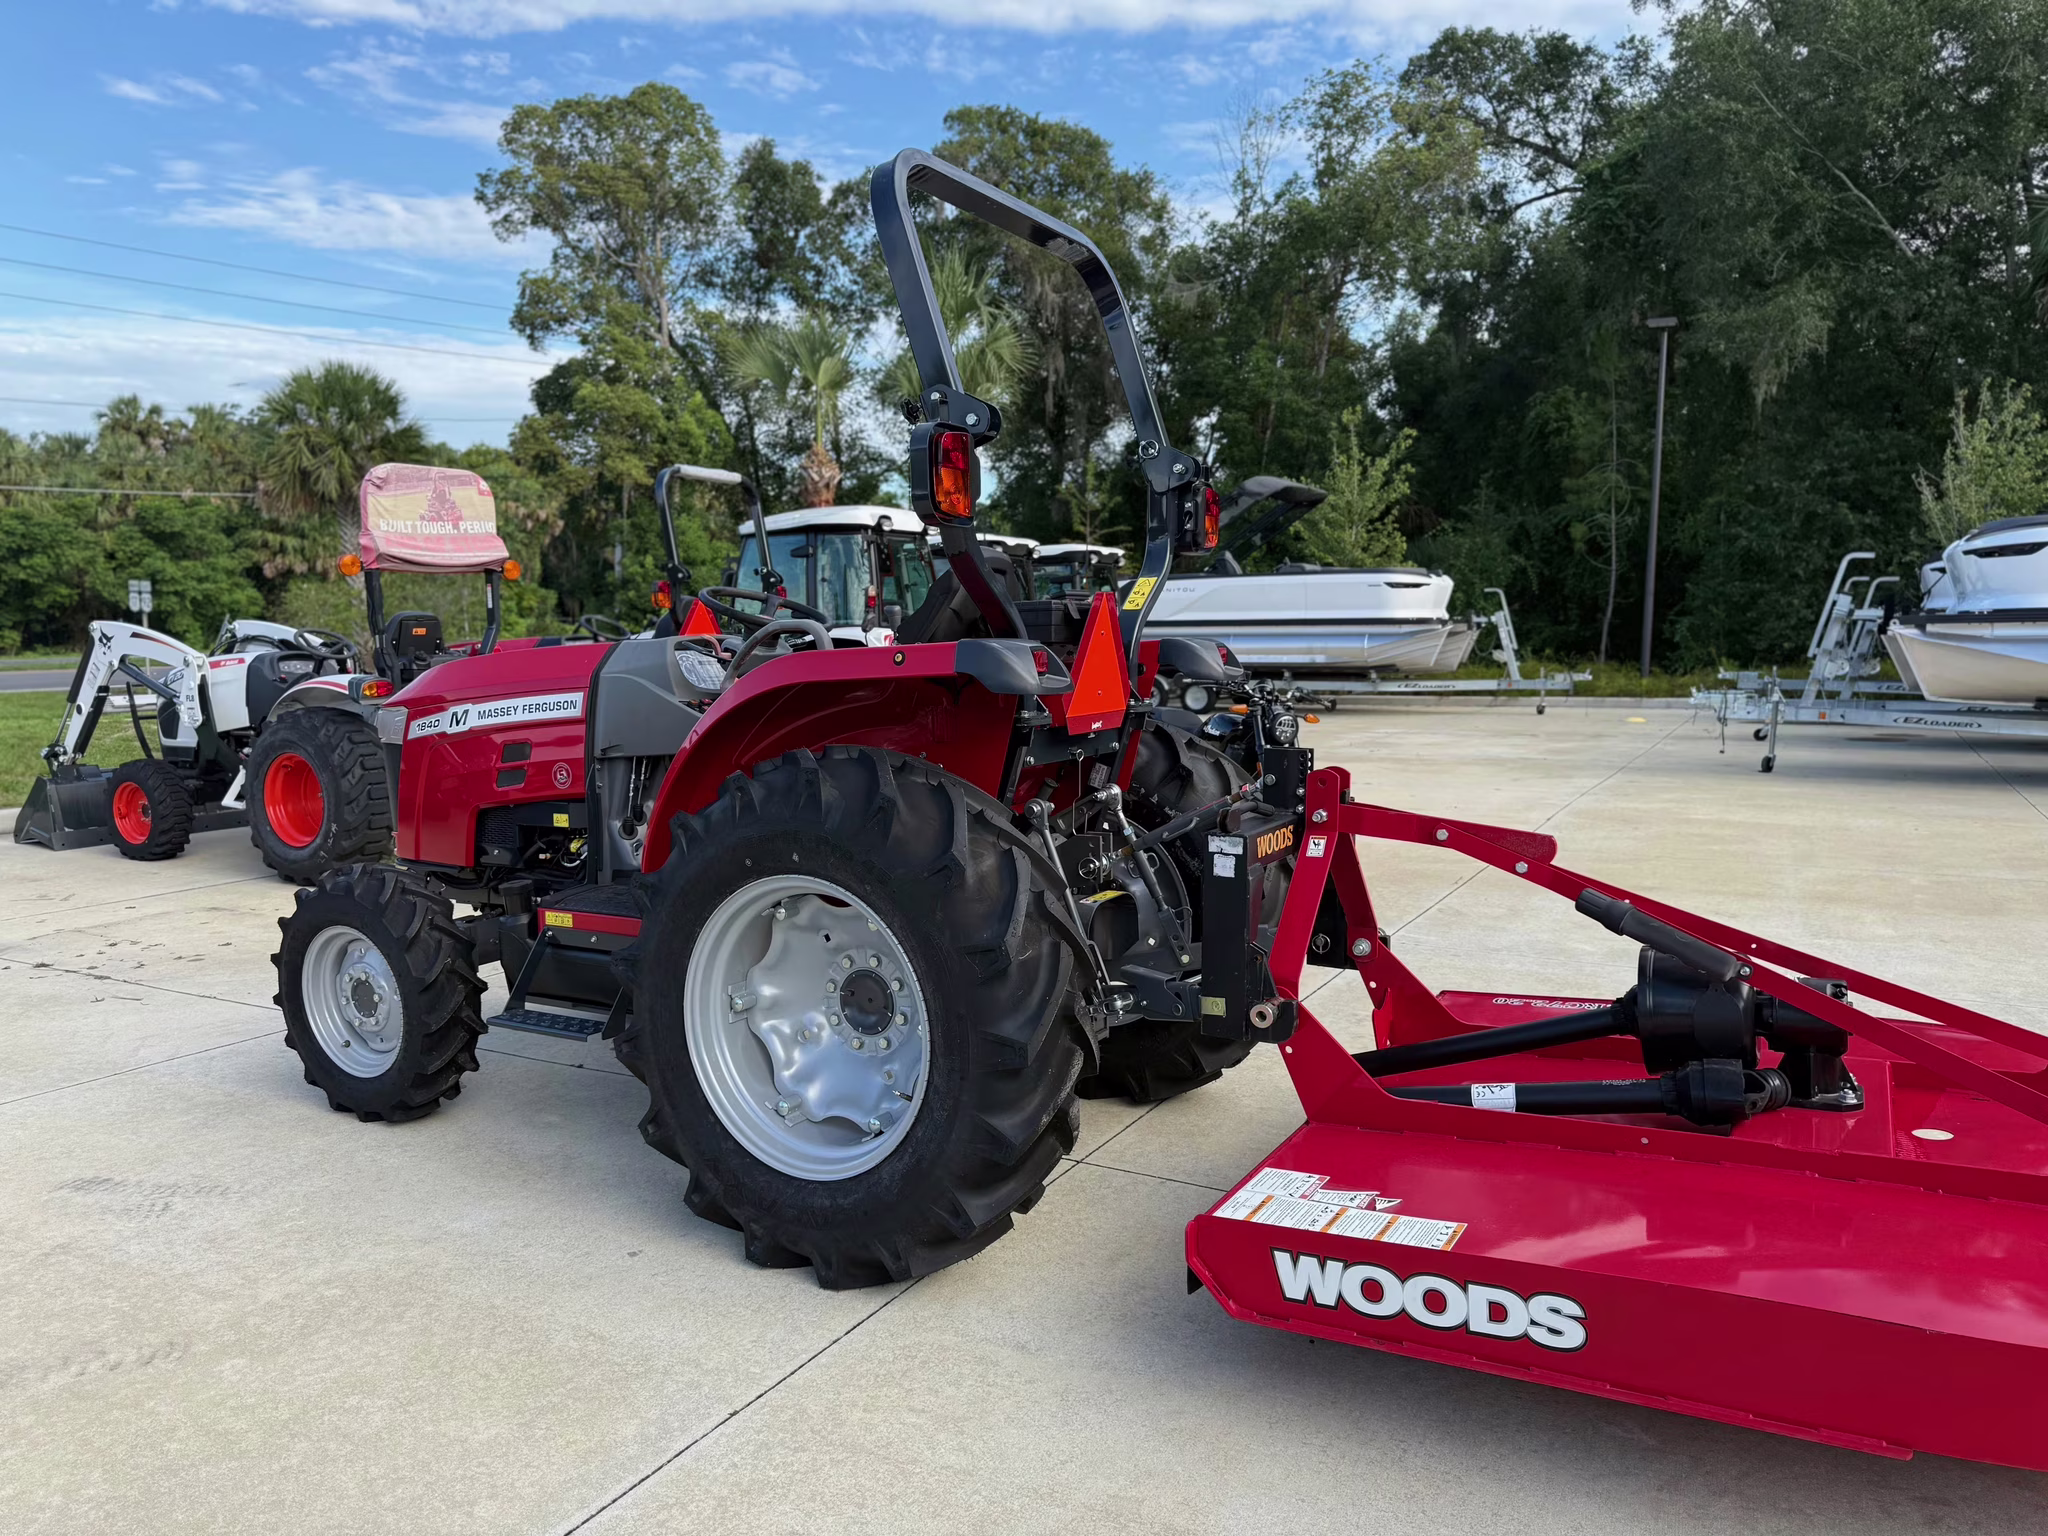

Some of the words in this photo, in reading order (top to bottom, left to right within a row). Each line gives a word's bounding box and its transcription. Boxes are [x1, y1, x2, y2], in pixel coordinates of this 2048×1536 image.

[379, 518, 414, 534] BUILT
[415, 520, 458, 535] TOUGH.
[477, 705, 519, 720] MASSEY
[522, 699, 578, 715] FERGUSON
[415, 718, 440, 732] 1840
[1257, 825, 1294, 858] WOODS
[1270, 1246, 1588, 1353] WOODS
